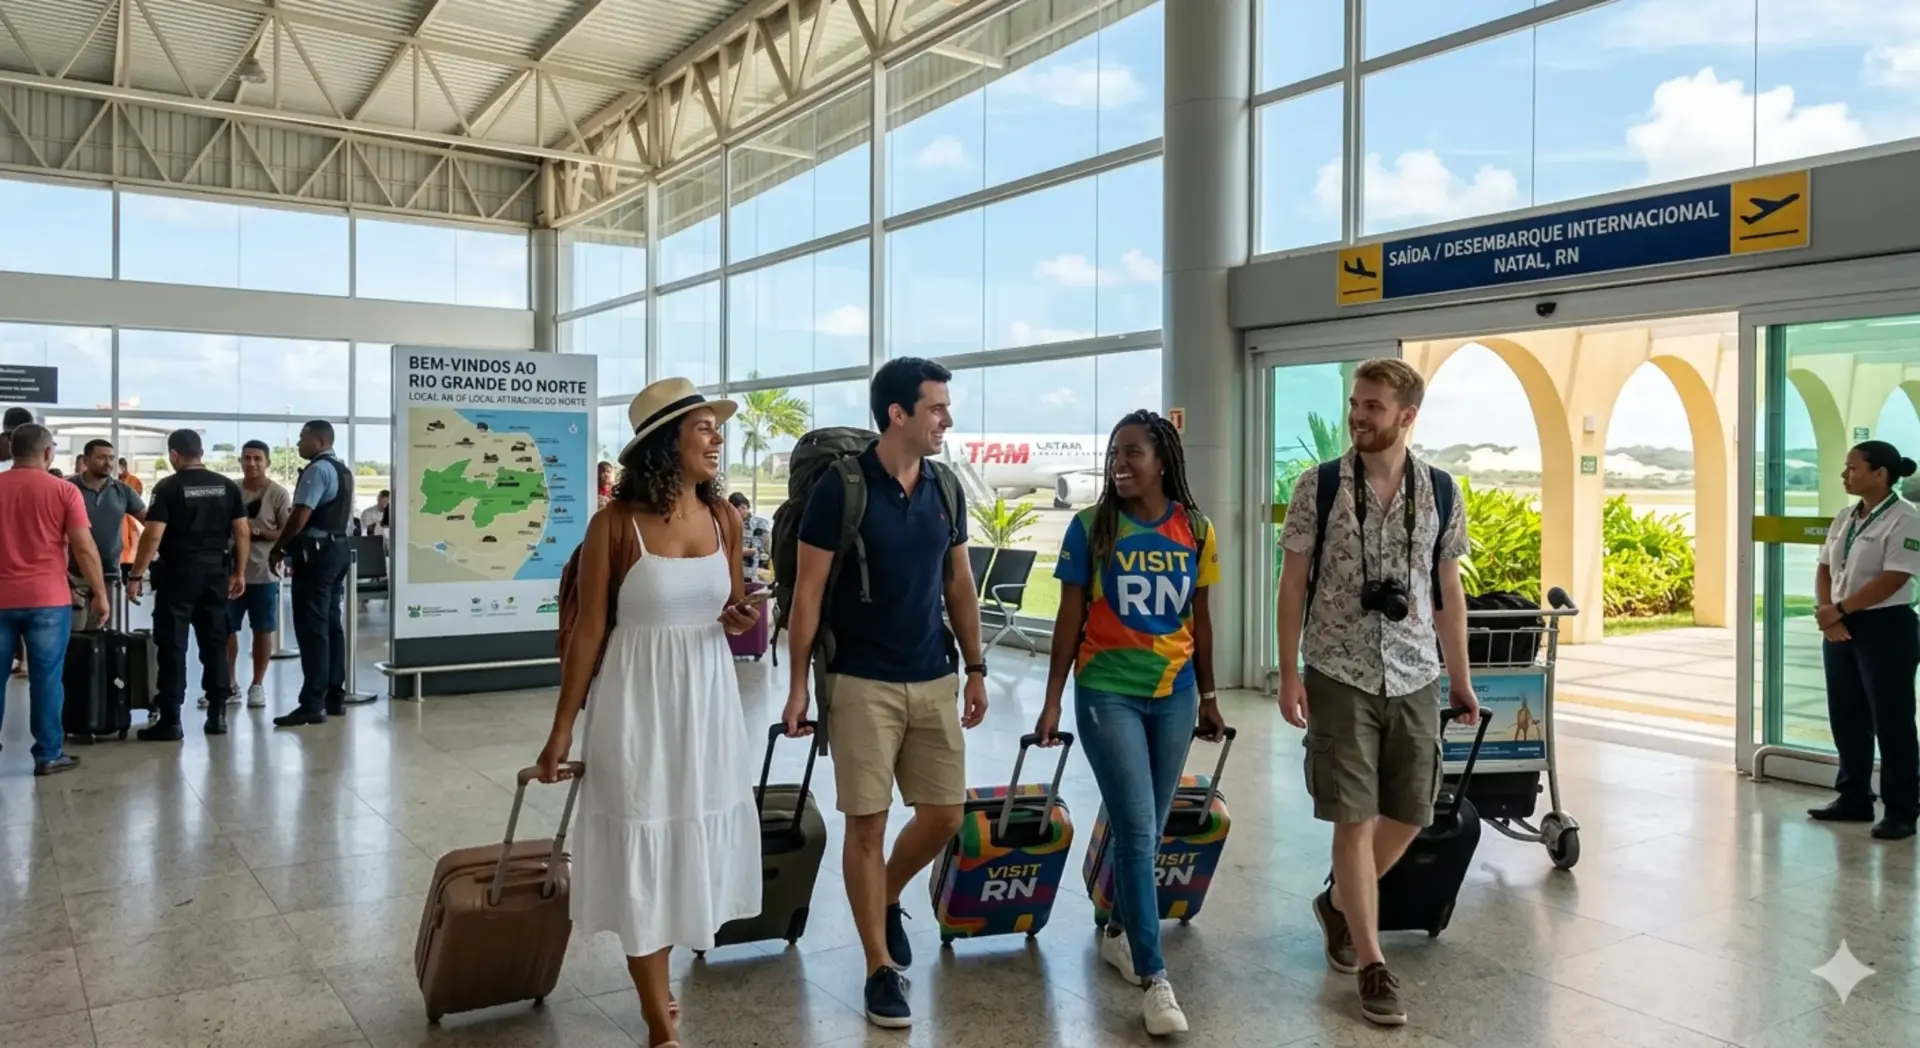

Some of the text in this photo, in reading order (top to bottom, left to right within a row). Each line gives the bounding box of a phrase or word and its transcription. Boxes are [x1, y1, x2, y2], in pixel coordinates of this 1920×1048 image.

[1389, 200, 1719, 266] SAÍDA / DESEMBARQUE INTERNACIONAL
[1494, 247, 1579, 274] NATAL, RN
[409, 356, 537, 375] BEM-VINDOS AO
[409, 374, 587, 394] RIO GRANDE DO NORTE
[469, 395, 495, 403] LOCAL
[559, 398, 586, 406] NORTE
[965, 442, 1030, 464] TAM
[1116, 551, 1189, 572] VISIT
[1117, 575, 1191, 616] RN
[987, 864, 1042, 879] VISIT
[980, 877, 1038, 902] RN
